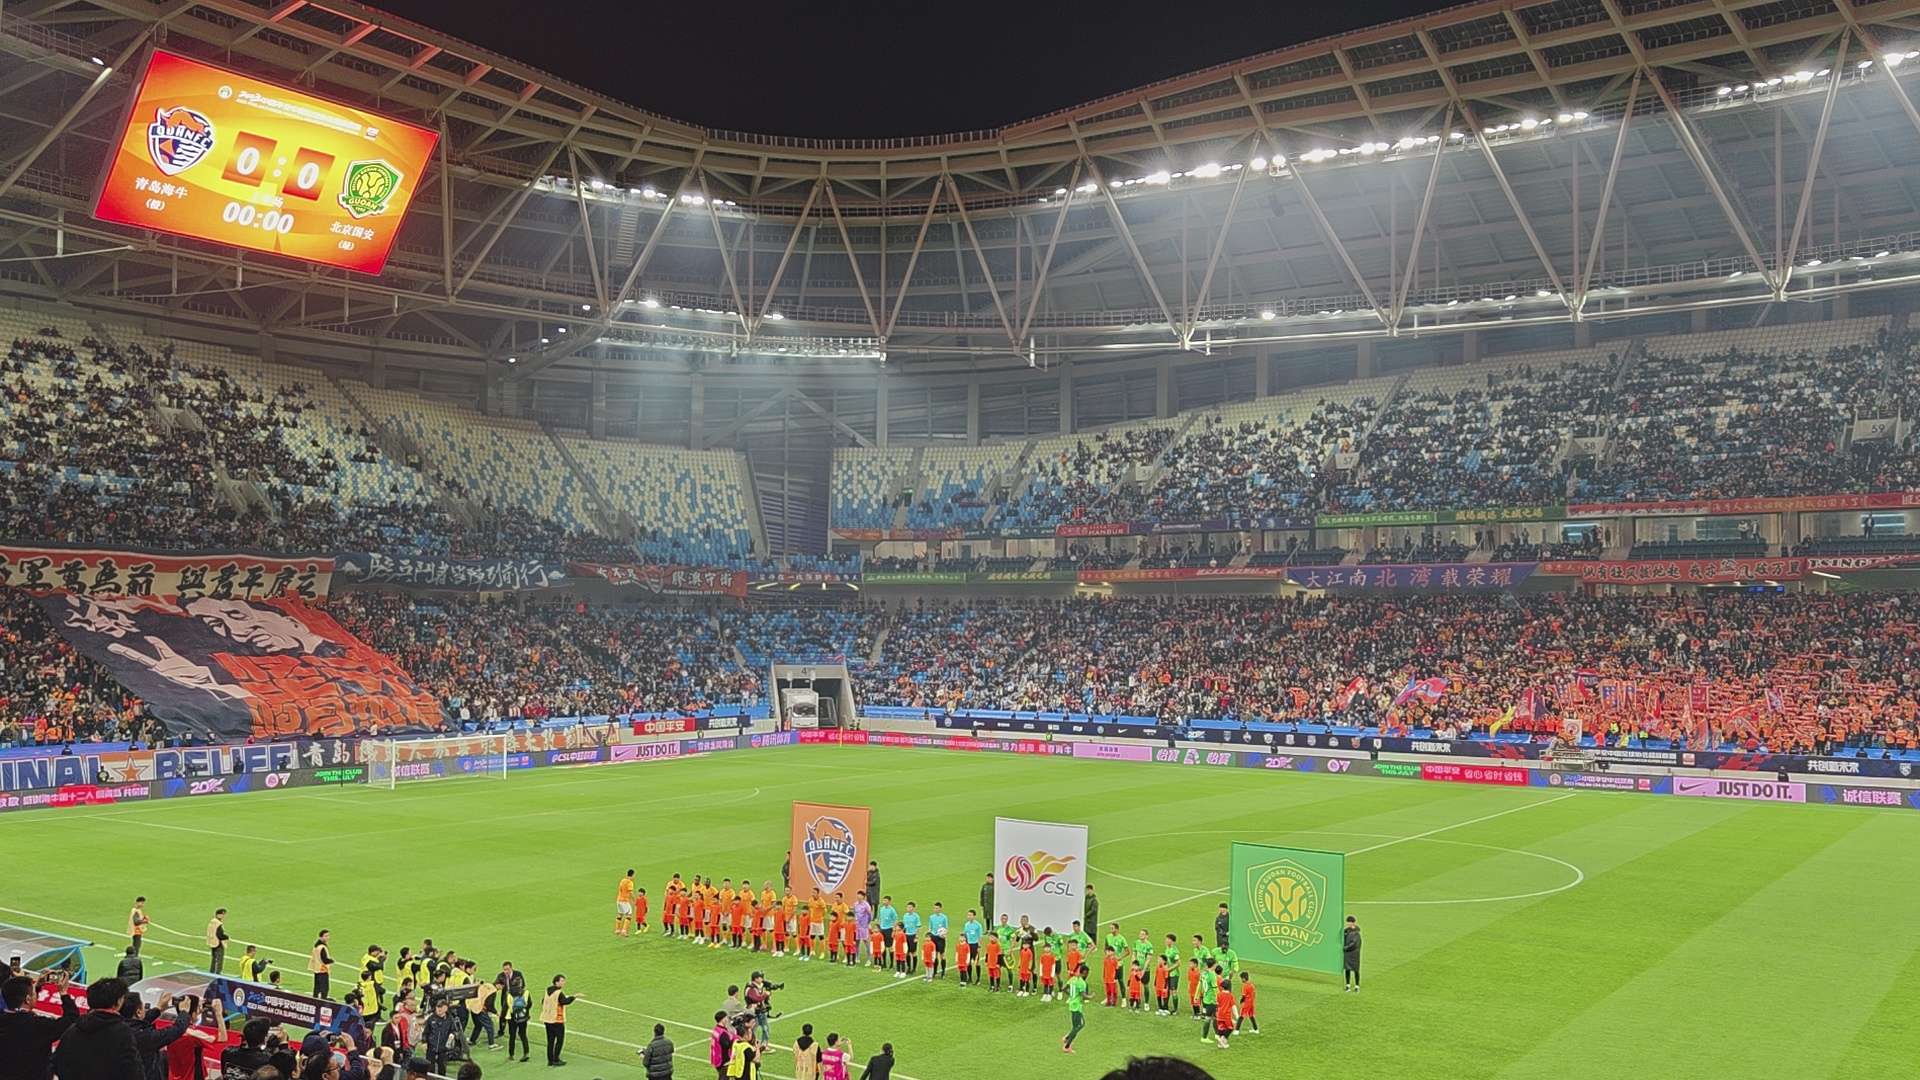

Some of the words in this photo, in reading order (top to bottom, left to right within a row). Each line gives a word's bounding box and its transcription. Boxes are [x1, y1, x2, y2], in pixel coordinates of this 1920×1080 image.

[236, 147, 260, 175] 0
[297, 162, 320, 190] 0
[223, 202, 295, 234] 00:00
[644, 720, 685, 733] 中国平安
[636, 745, 655, 757] JUST
[656, 744, 668, 755] DO
[1717, 782, 1750, 796] JUST
[1752, 784, 1774, 798] DO
[1776, 785, 1793, 799] IT.
[1843, 789, 1902, 805] 诚信联赛
[1043, 880, 1074, 896] CSL
[1262, 925, 1310, 941] GUOAN
